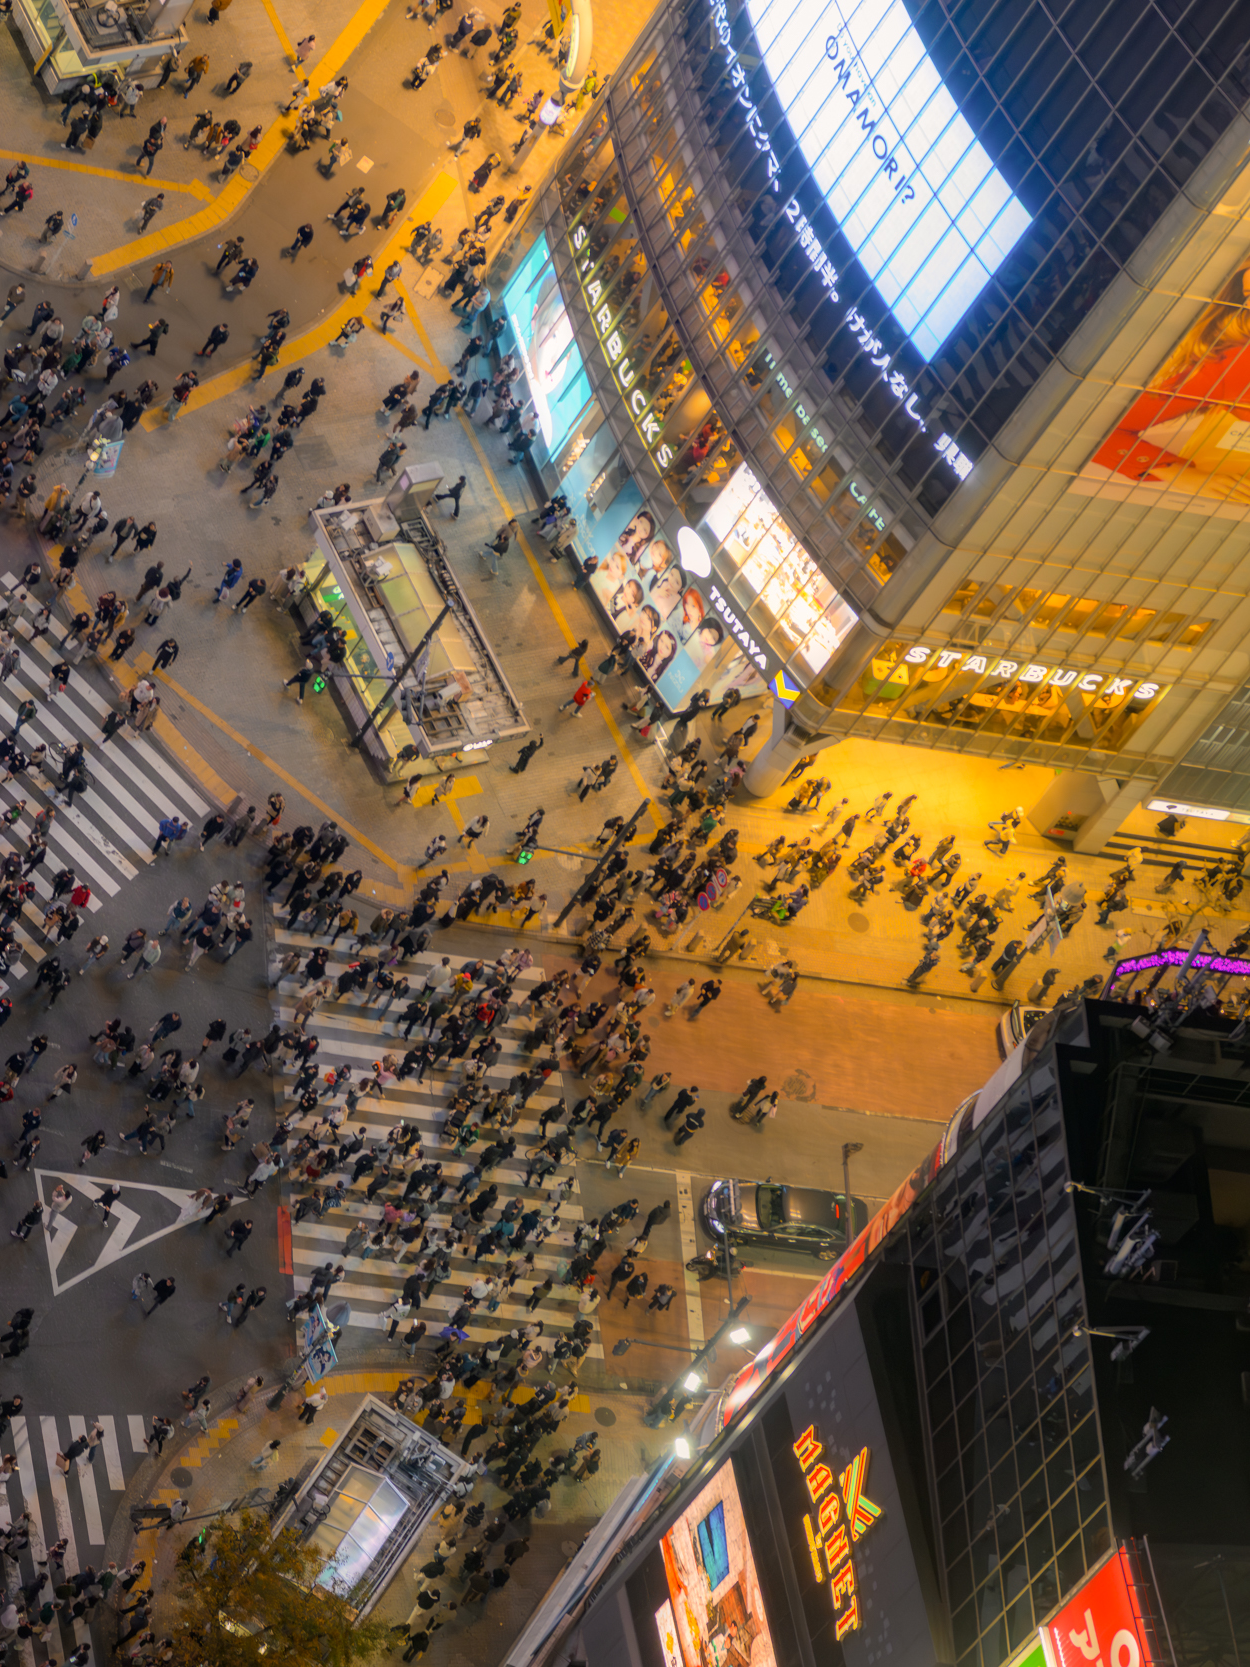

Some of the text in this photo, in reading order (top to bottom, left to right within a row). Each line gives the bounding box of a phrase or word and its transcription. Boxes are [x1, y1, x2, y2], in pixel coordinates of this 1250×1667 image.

[825, 35, 915, 205] OMAMORI?
[709, 585, 767, 670] TSUTAYA
[904, 646, 1160, 699] STARBUCKS
[793, 1424, 859, 1642] MAGNET
